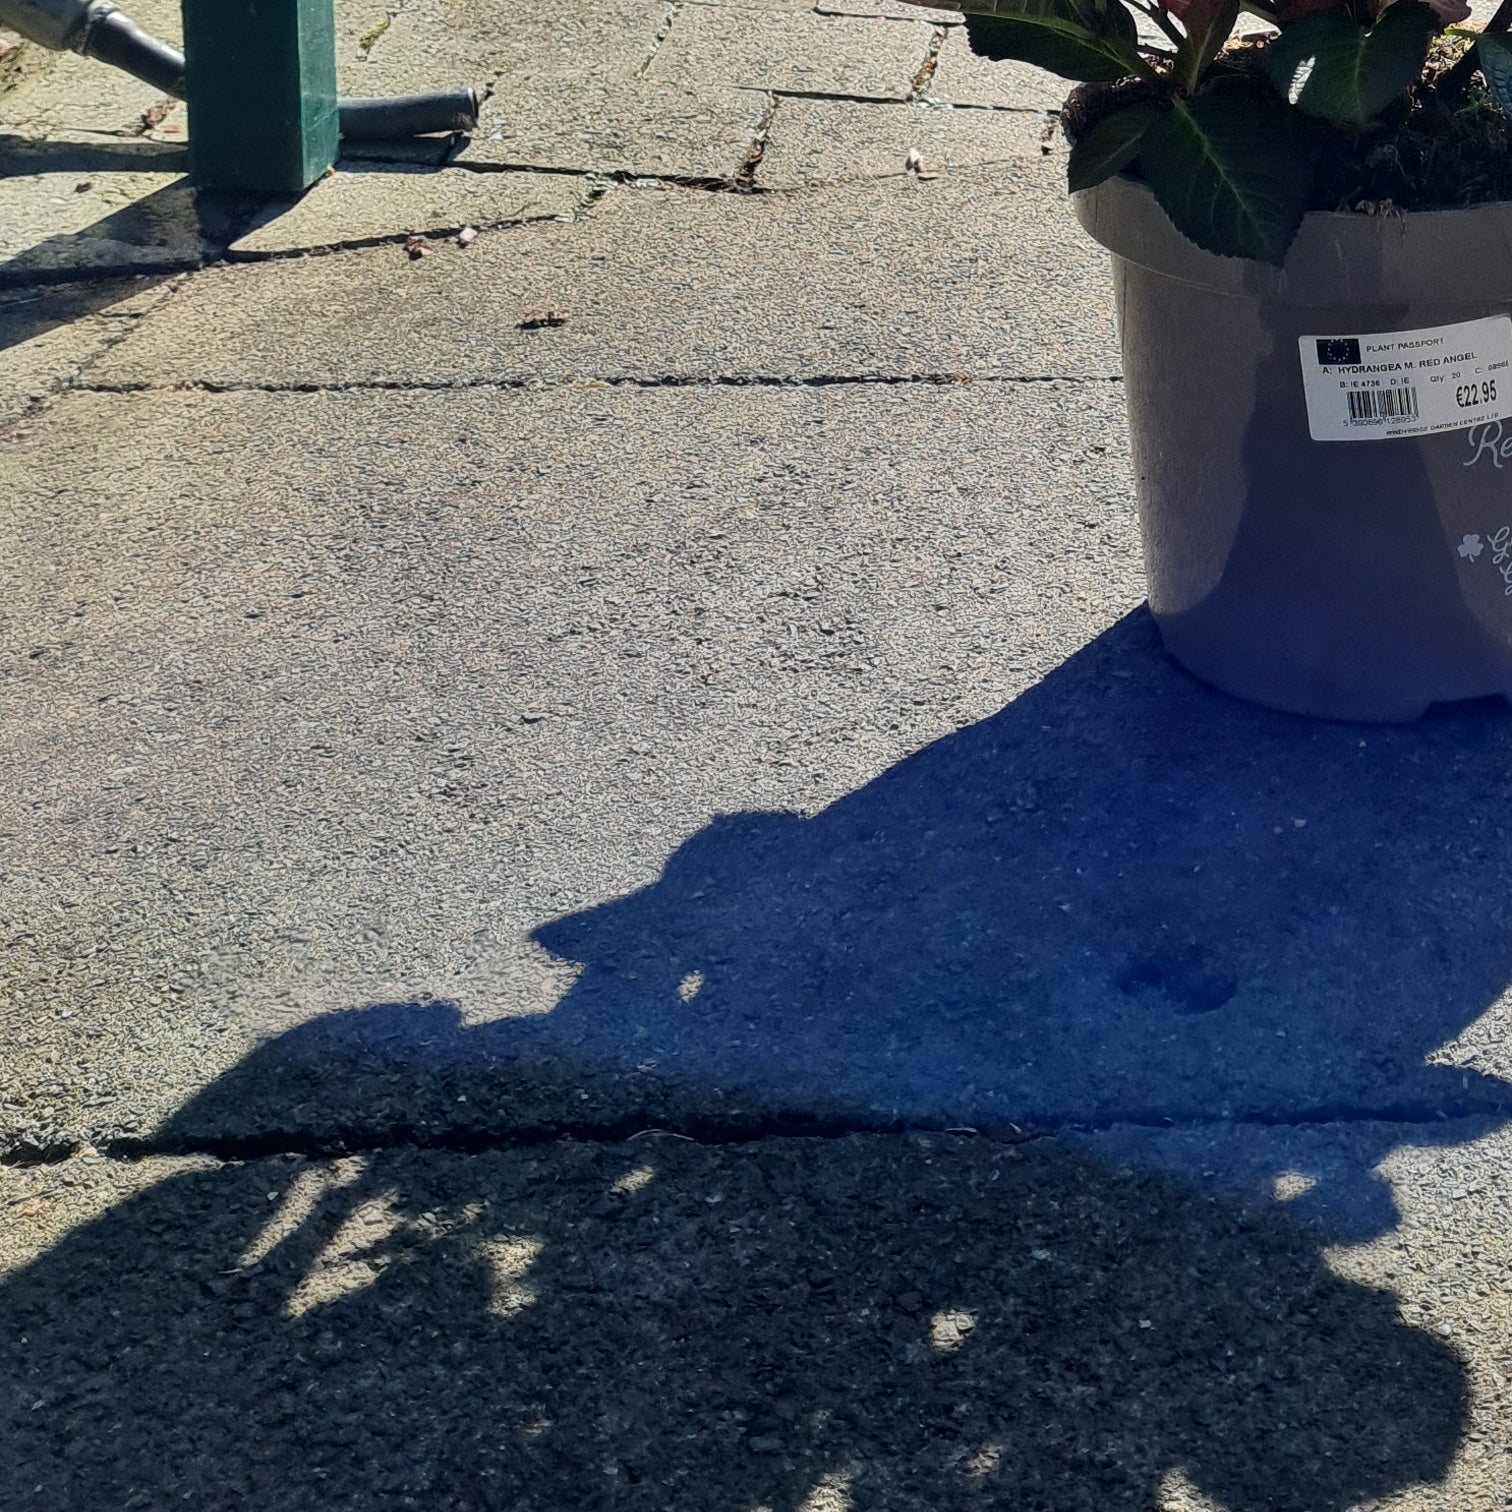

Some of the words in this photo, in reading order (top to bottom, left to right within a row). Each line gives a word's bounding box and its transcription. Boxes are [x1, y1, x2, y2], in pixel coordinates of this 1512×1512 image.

[1366, 343, 1395, 353] PLANT
[1397, 337, 1444, 350] PASSPORT
[1322, 366, 1333, 375] A:
[1338, 363, 1401, 374] HYDRANGEA
[1404, 361, 1416, 370] M.
[1419, 358, 1441, 368] RED
[1443, 351, 1478, 364] ANGEL
[1350, 380, 1359, 388] IE
[1401, 376, 1410, 384] IE
[1451, 371, 1461, 379] 20
[1456, 379, 1497, 408] €22.95
